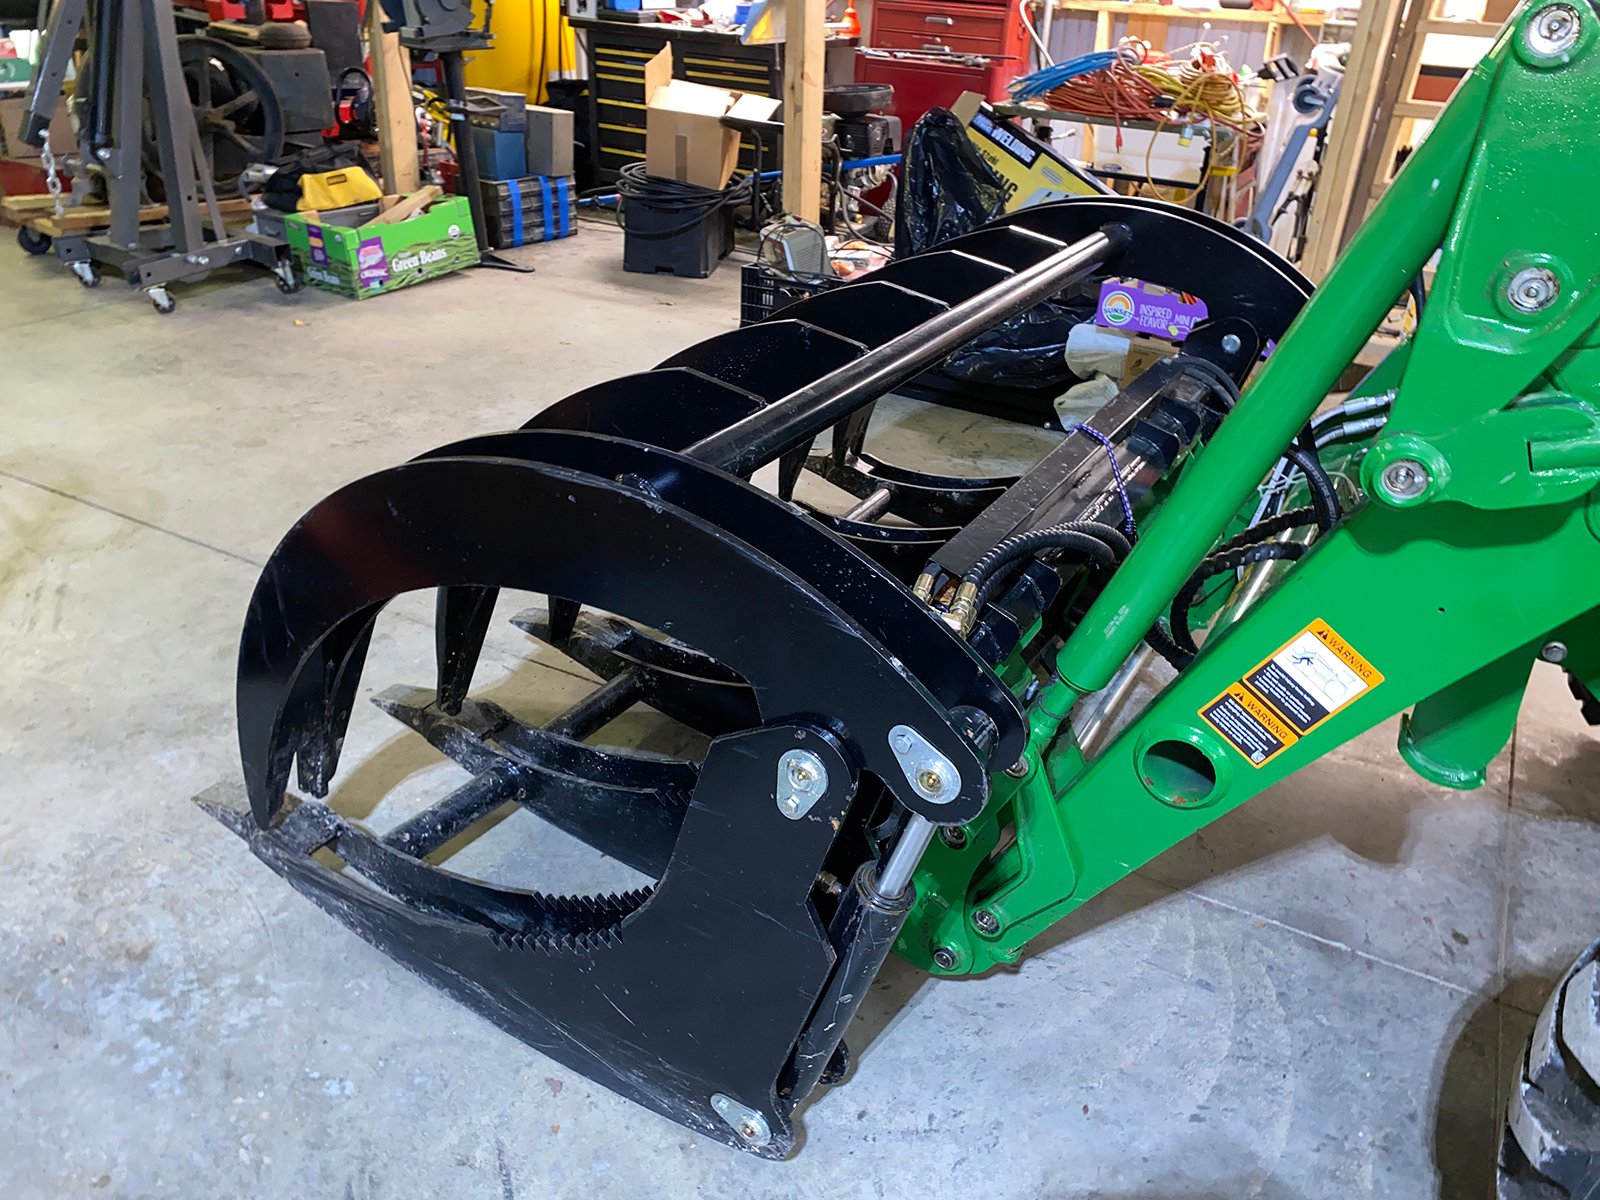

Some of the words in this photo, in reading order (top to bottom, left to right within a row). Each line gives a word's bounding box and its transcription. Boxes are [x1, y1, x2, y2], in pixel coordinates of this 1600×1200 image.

[991, 126, 1036, 164] WELDING
[392, 256, 420, 273] Green
[419, 248, 447, 265] Beans
[1139, 315, 1169, 331] FLAVOR
[1140, 303, 1173, 320] INSPIRED
[1174, 313, 1191, 327] MINI
[1329, 637, 1373, 678] WARNING
[1247, 701, 1288, 739] WARNING
